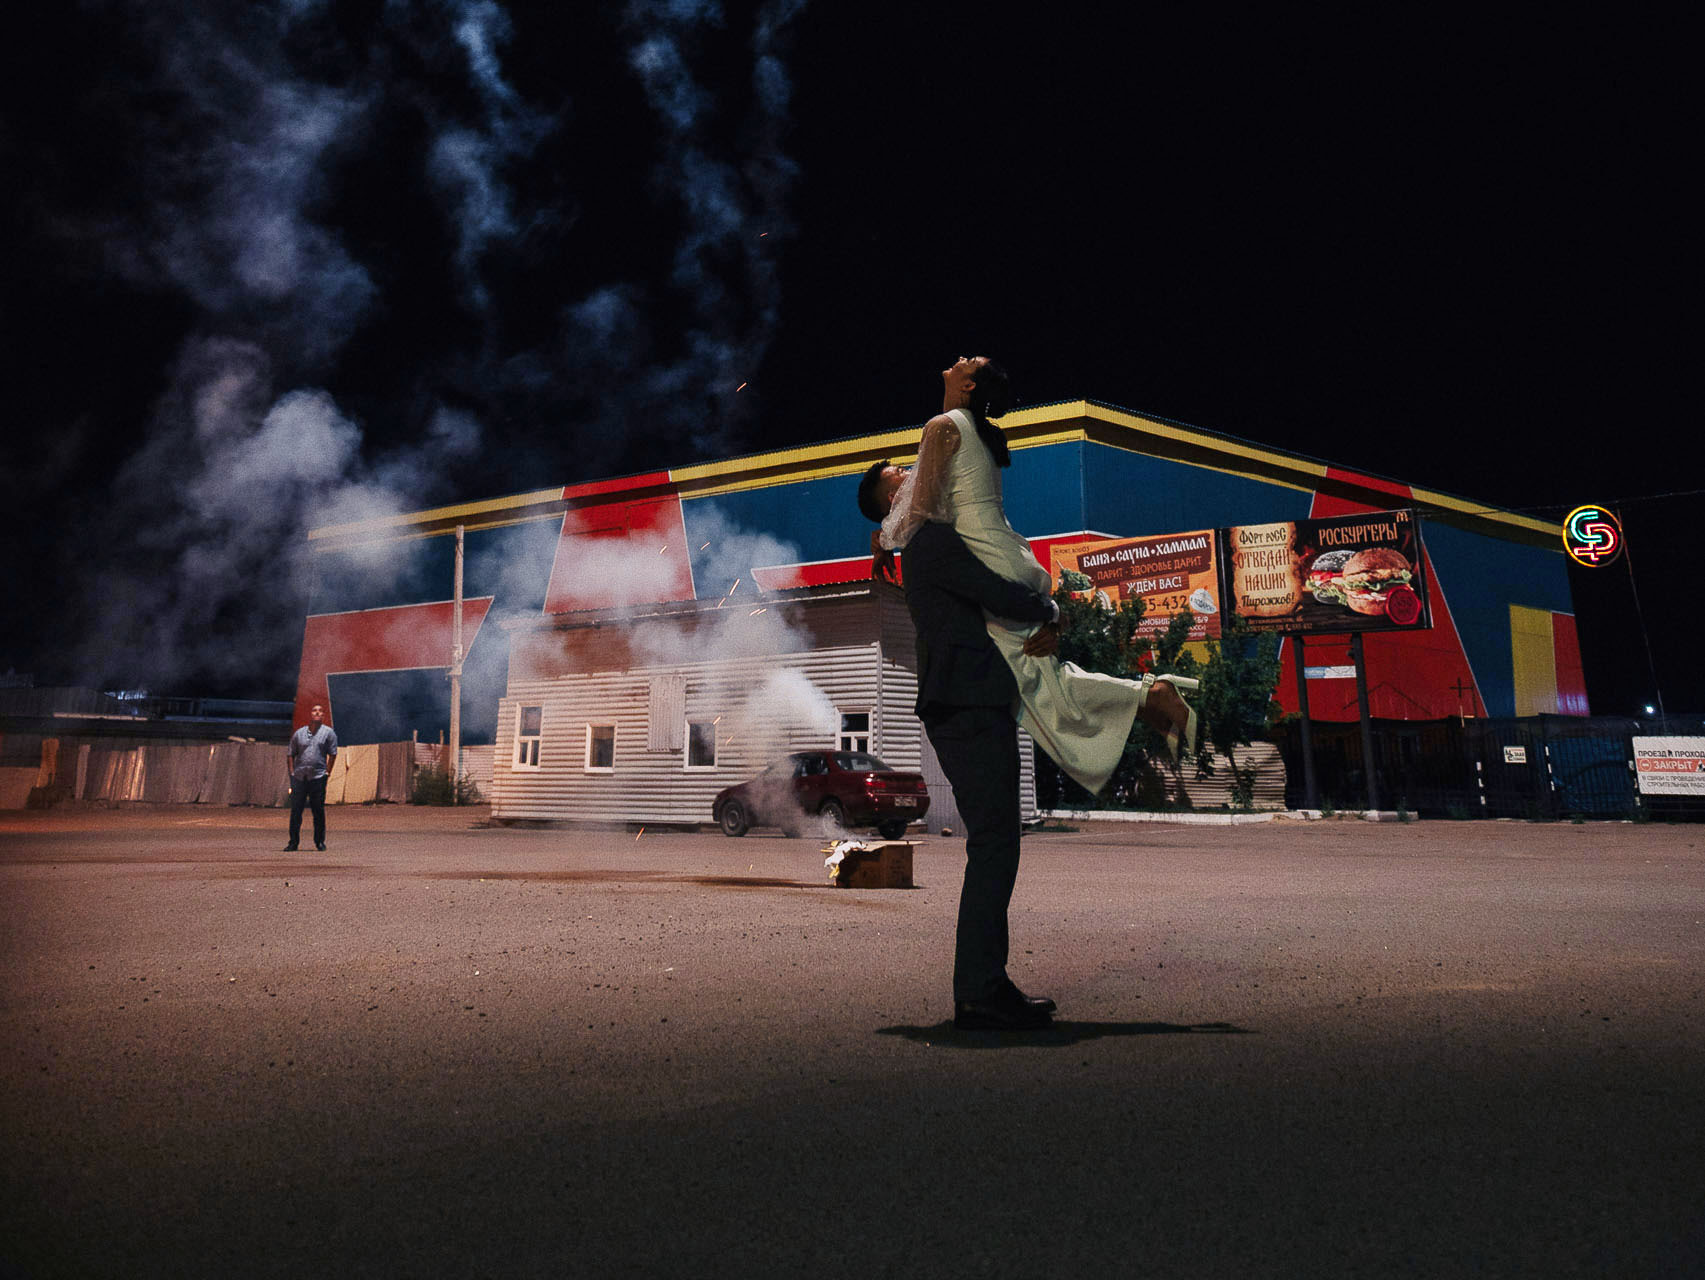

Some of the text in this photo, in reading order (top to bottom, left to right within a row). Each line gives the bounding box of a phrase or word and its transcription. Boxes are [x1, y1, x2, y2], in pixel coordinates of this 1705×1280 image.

[1318, 522, 1398, 546] РОСБУРГЕРЫ
[1083, 537, 1207, 568] БАНЯ САУНА ХАММАМ
[1237, 546, 1290, 572] ОТВЕДАЙ
[1096, 556, 1202, 580] ПАРИТ ЗДОРОВЬЕ ДАРИТ
[1127, 575, 1183, 594] ЖДЁМ ВАС!
[1245, 572, 1287, 591] НАШИХ
[1142, 595, 1188, 611] 5-432
[1241, 592, 1295, 611] Пирожков!
[1674, 750, 1705, 758] ПРОХОД
[1654, 760, 1693, 770] ЗАКРЫТ
